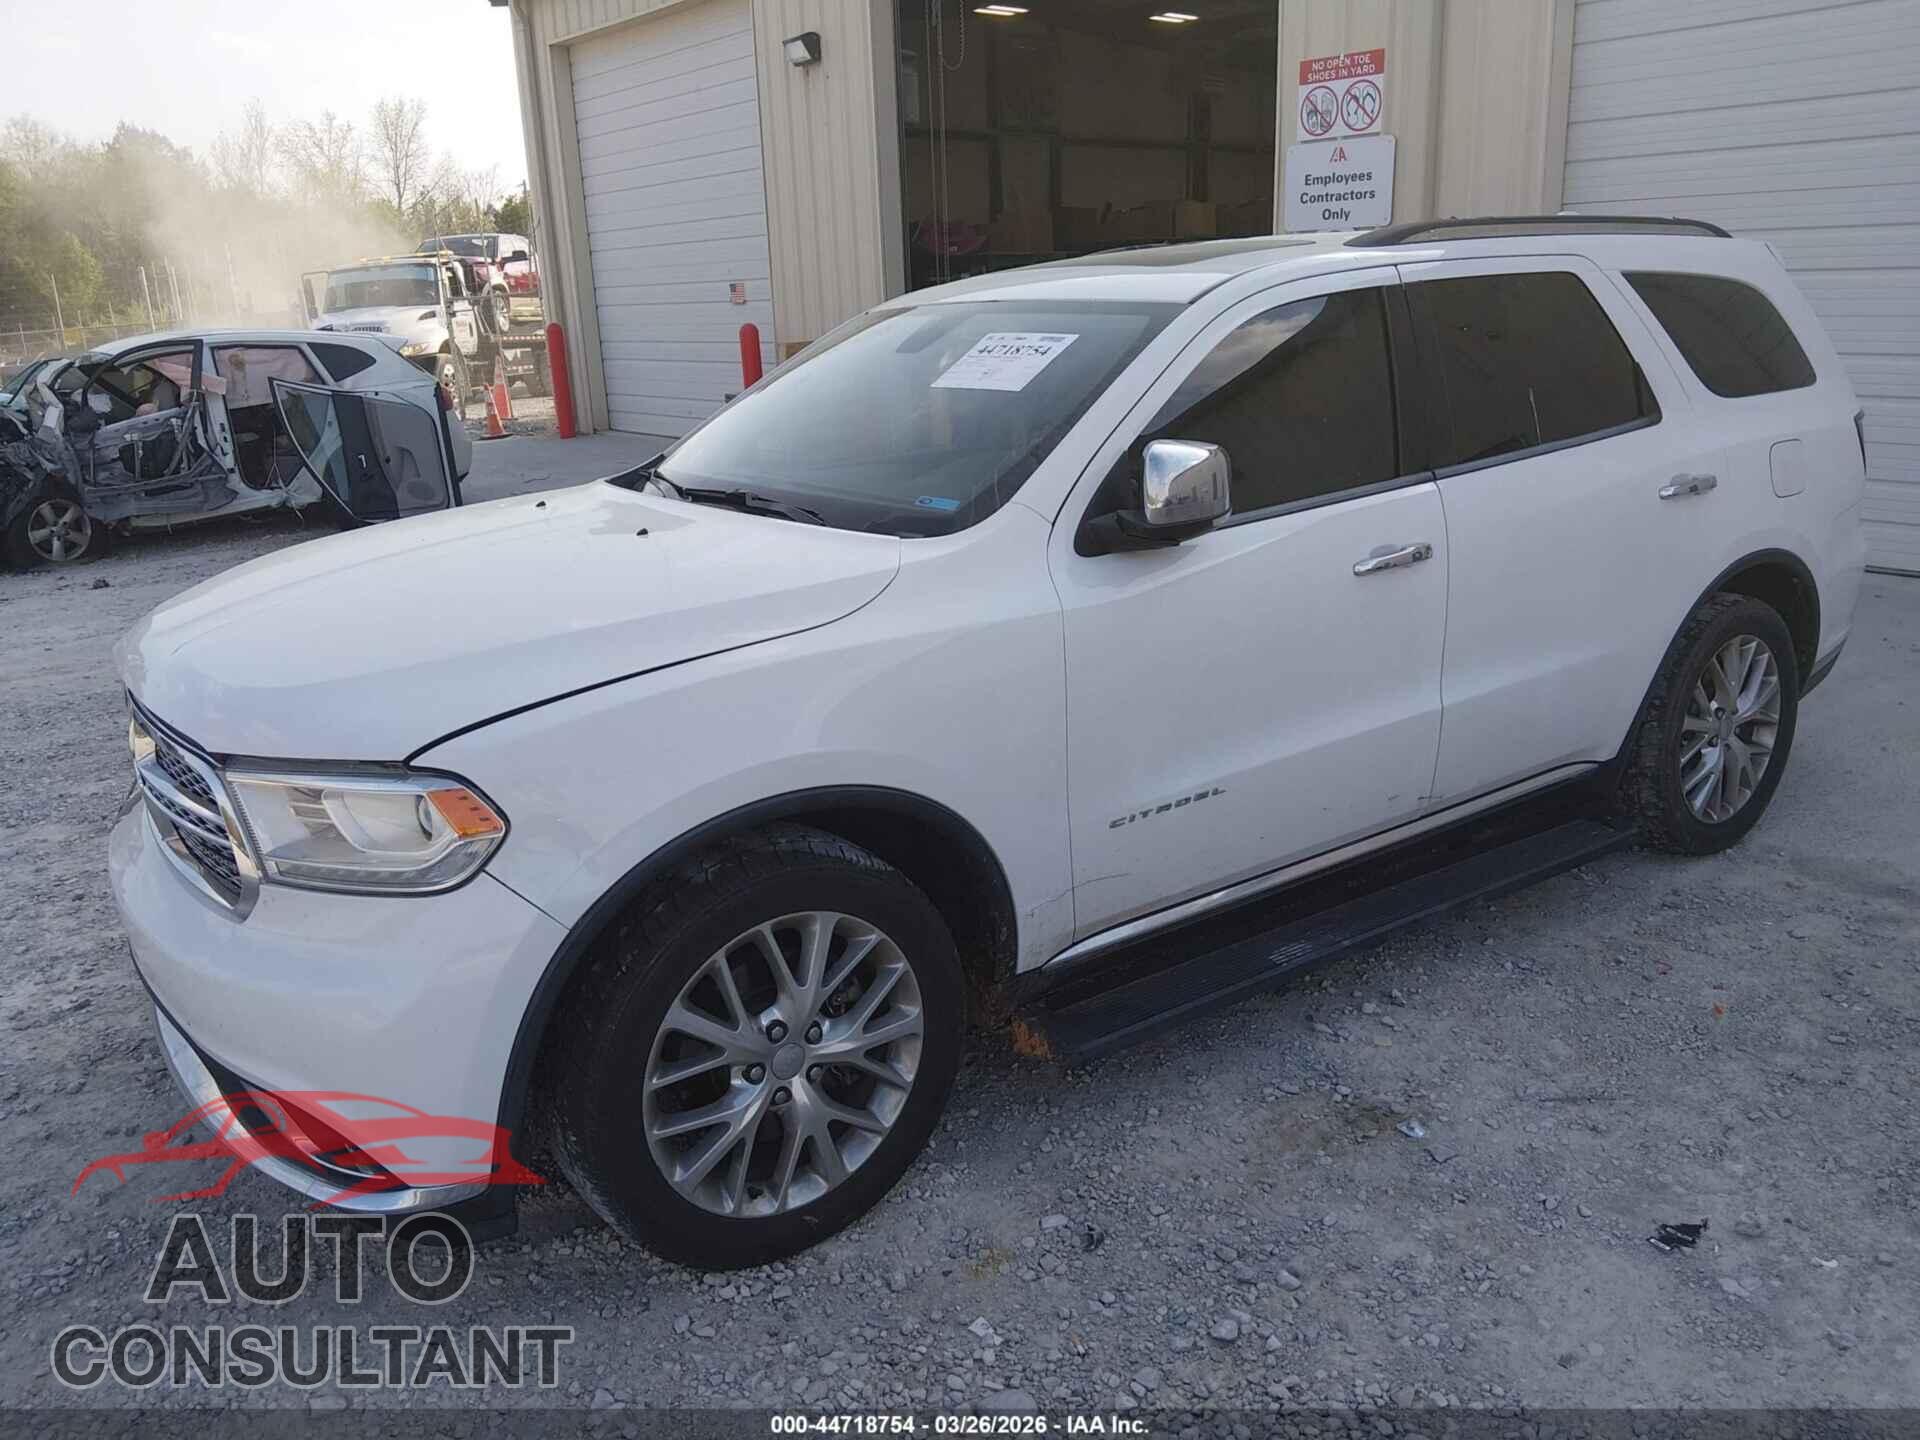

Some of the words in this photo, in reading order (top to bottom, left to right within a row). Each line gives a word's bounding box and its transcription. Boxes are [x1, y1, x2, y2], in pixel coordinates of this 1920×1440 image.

[1312, 59, 1325, 71] NO
[1326, 56, 1351, 69] OPEN
[1353, 53, 1371, 64] TOE
[1307, 70, 1336, 82] SHOES
[1338, 68, 1348, 78] IN
[1350, 64, 1376, 76] YARD
[1304, 170, 1373, 187] Employees
[1300, 188, 1376, 204] Contractors
[1322, 208, 1351, 221] Only
[1109, 787, 1226, 829] CITADEL
